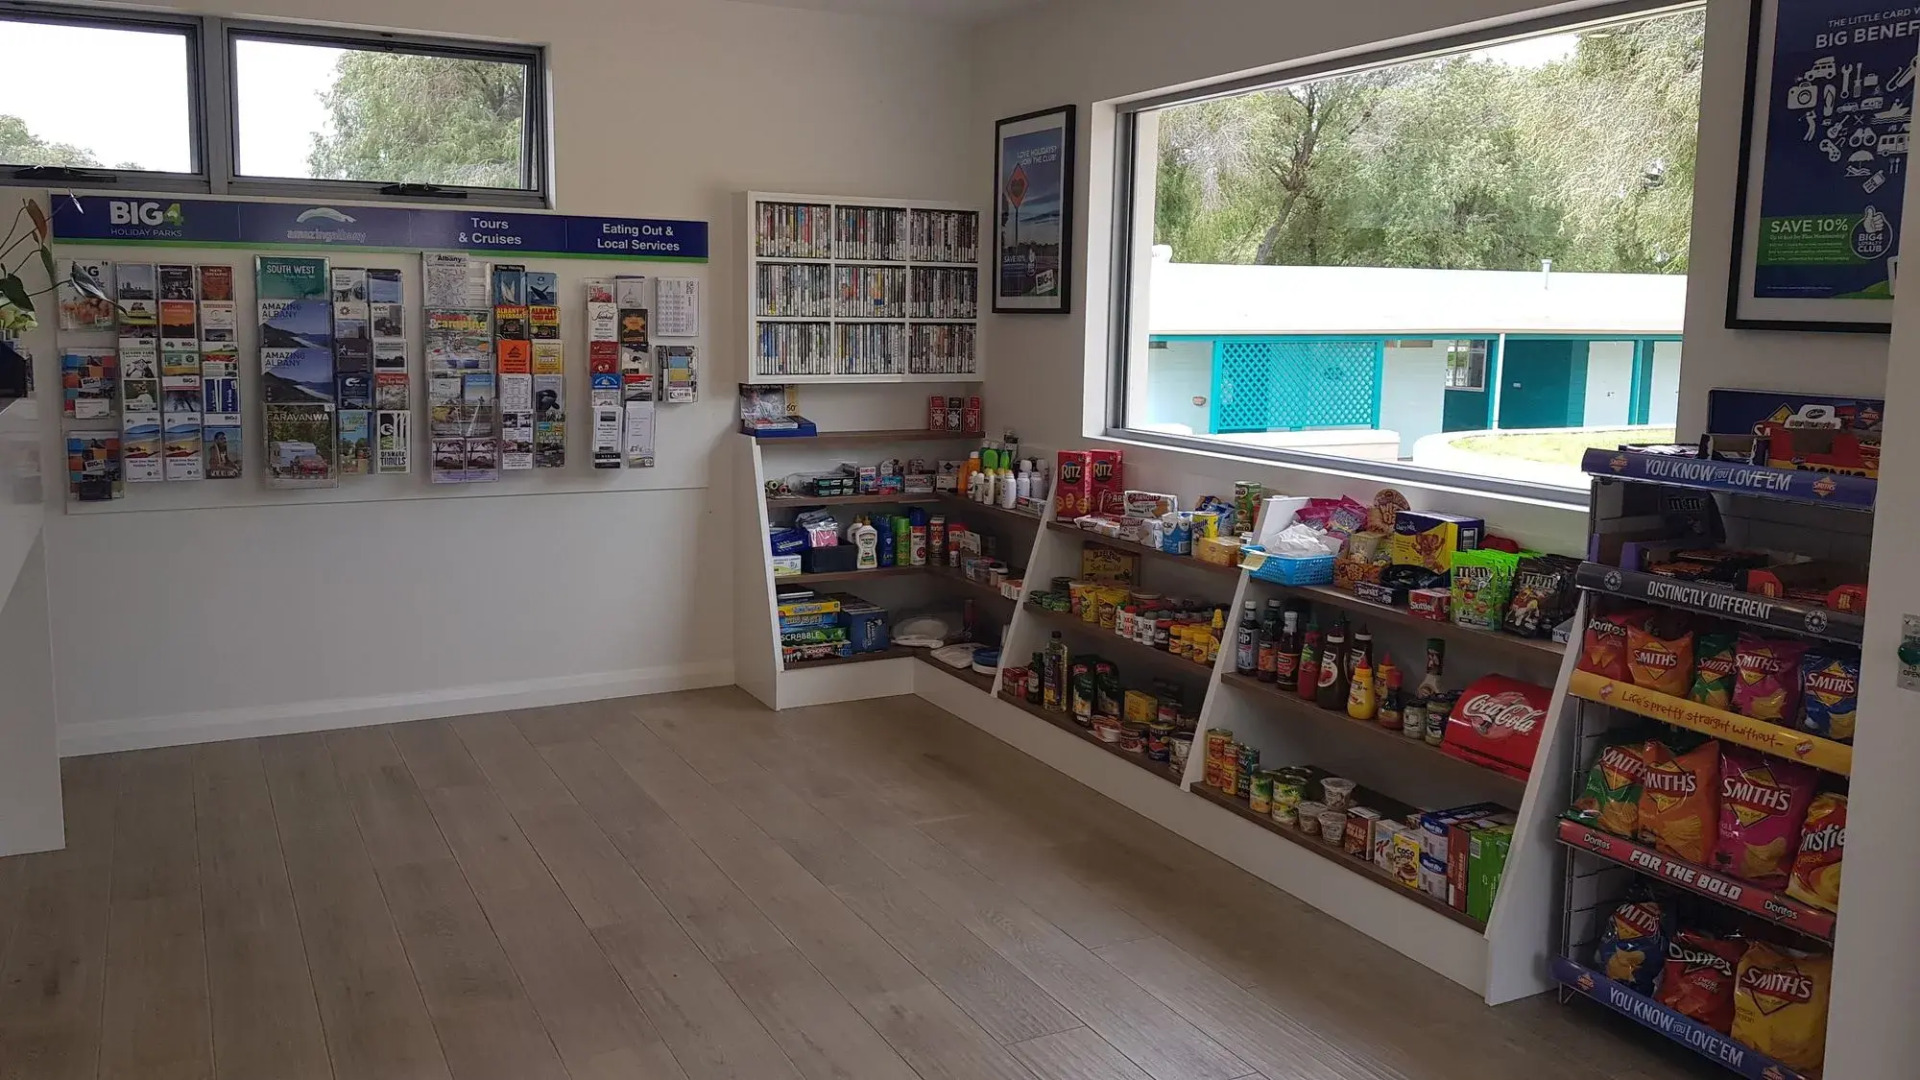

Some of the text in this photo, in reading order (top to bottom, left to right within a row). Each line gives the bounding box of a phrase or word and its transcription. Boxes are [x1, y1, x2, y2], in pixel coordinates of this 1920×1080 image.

[1828, 18, 1847, 28] THE
[1849, 12, 1881, 25] LITTLE
[1883, 8, 1911, 20] CARD
[1814, 19, 1920, 49] BIG BENEF
[110, 201, 184, 226] BIG4
[471, 217, 509, 230] Tours
[603, 223, 674, 237] Eating Out &
[1771, 218, 1848, 233] SAVE 10%
[110, 228, 182, 237] HOLIDAY PARKS
[458, 233, 522, 245] & Cruises
[1857, 233, 1884, 242] BIG4
[597, 238, 680, 251] Local Services
[1857, 245, 1882, 253] CLUB
[438, 254, 462, 263] Albany
[266, 265, 316, 274] SOUTH WEST
[261, 303, 302, 311] AMAZING
[262, 310, 298, 319] ALBANY
[265, 351, 306, 360] AMAZING
[265, 359, 301, 367] ALBANY
[267, 412, 329, 422] CARAVANWA
[1061, 466, 1081, 479] RITZ
[1093, 463, 1113, 477] RITZ
[1645, 458, 1669, 476] YOU
[1670, 462, 1715, 483] KNOW
[1714, 470, 1729, 480] YOU
[1410, 601, 1435, 612] Skittles
[1647, 580, 1774, 621] DISTINCTLY DIFFERENT
[1588, 617, 1627, 637] Doritos
[781, 631, 820, 642] SCRABBLE
[1238, 633, 1250, 643] HP
[1634, 650, 1679, 667] SMITH'S
[1735, 653, 1781, 673] SMITH'S
[1805, 672, 1856, 694] SMITH'S
[1463, 694, 1547, 732] Coca-Cola
[1621, 690, 1650, 708] Life's
[1650, 702, 1685, 720] pretty
[1684, 709, 1731, 731] straight
[1722, 777, 1792, 811] SMITH'S
[1375, 840, 1390, 857] K
[1583, 833, 1611, 850] Doritos
[1629, 850, 1743, 901] FOR THE BOLD
[1615, 902, 1660, 932] MITH'S
[1764, 900, 1798, 920] Doritos
[1667, 942, 1732, 977] Doritos
[1741, 966, 1812, 999] SMITH'S
[1610, 987, 1633, 1012] YOU
[1634, 999, 1674, 1033] KNOW
[1673, 1021, 1686, 1035] YOU
